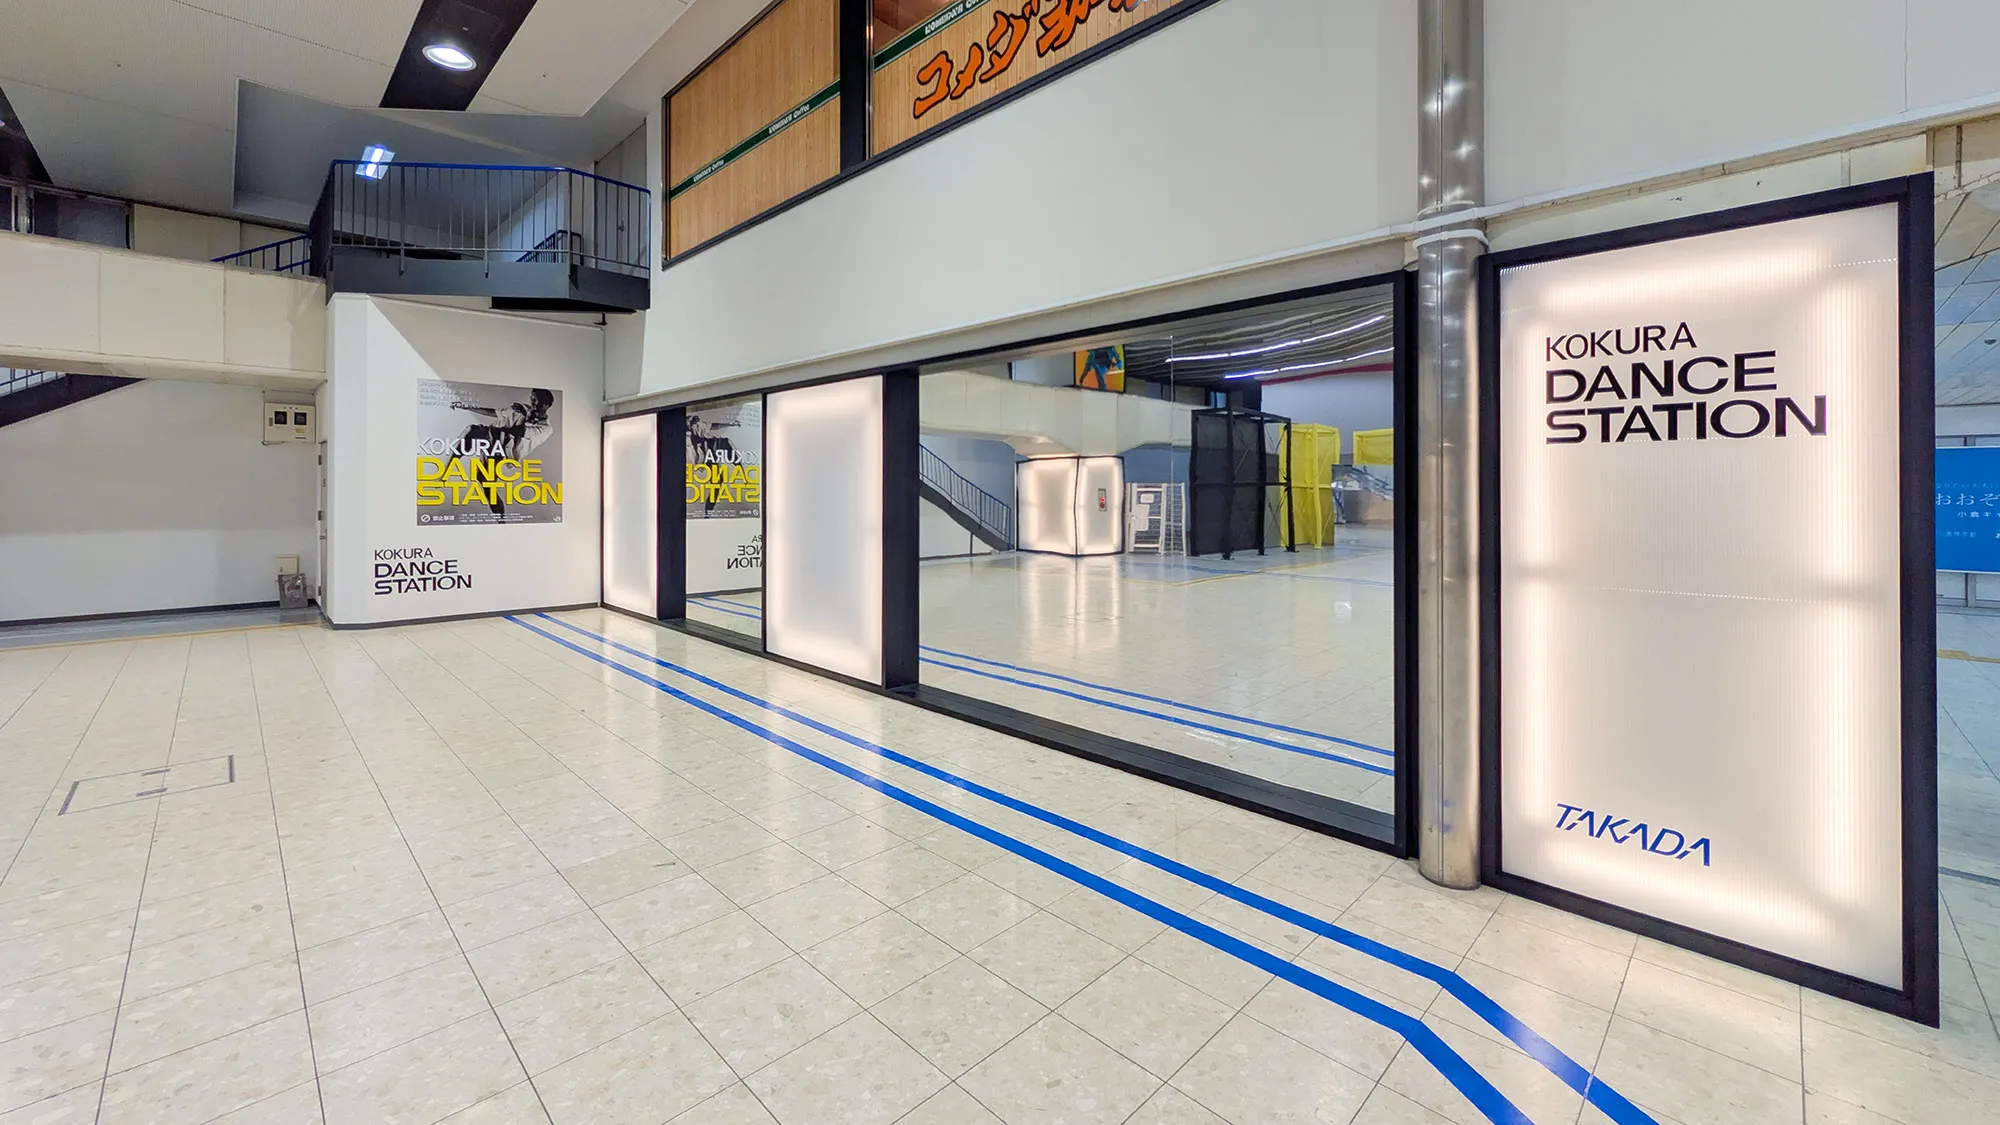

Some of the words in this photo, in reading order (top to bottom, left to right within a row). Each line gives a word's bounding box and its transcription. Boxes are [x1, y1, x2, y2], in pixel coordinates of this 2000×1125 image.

[1546, 321, 1698, 363] KOKURA
[1546, 350, 1778, 405] DANCE
[1546, 394, 1828, 446] STATION
[418, 437, 507, 457] KOKURA
[417, 457, 543, 482] DANCE
[417, 482, 563, 506] STATION
[375, 548, 434, 561] KOKURA
[375, 560, 458, 579] DANCE
[375, 575, 472, 596] STATION
[1555, 803, 1711, 867] TAKADA
